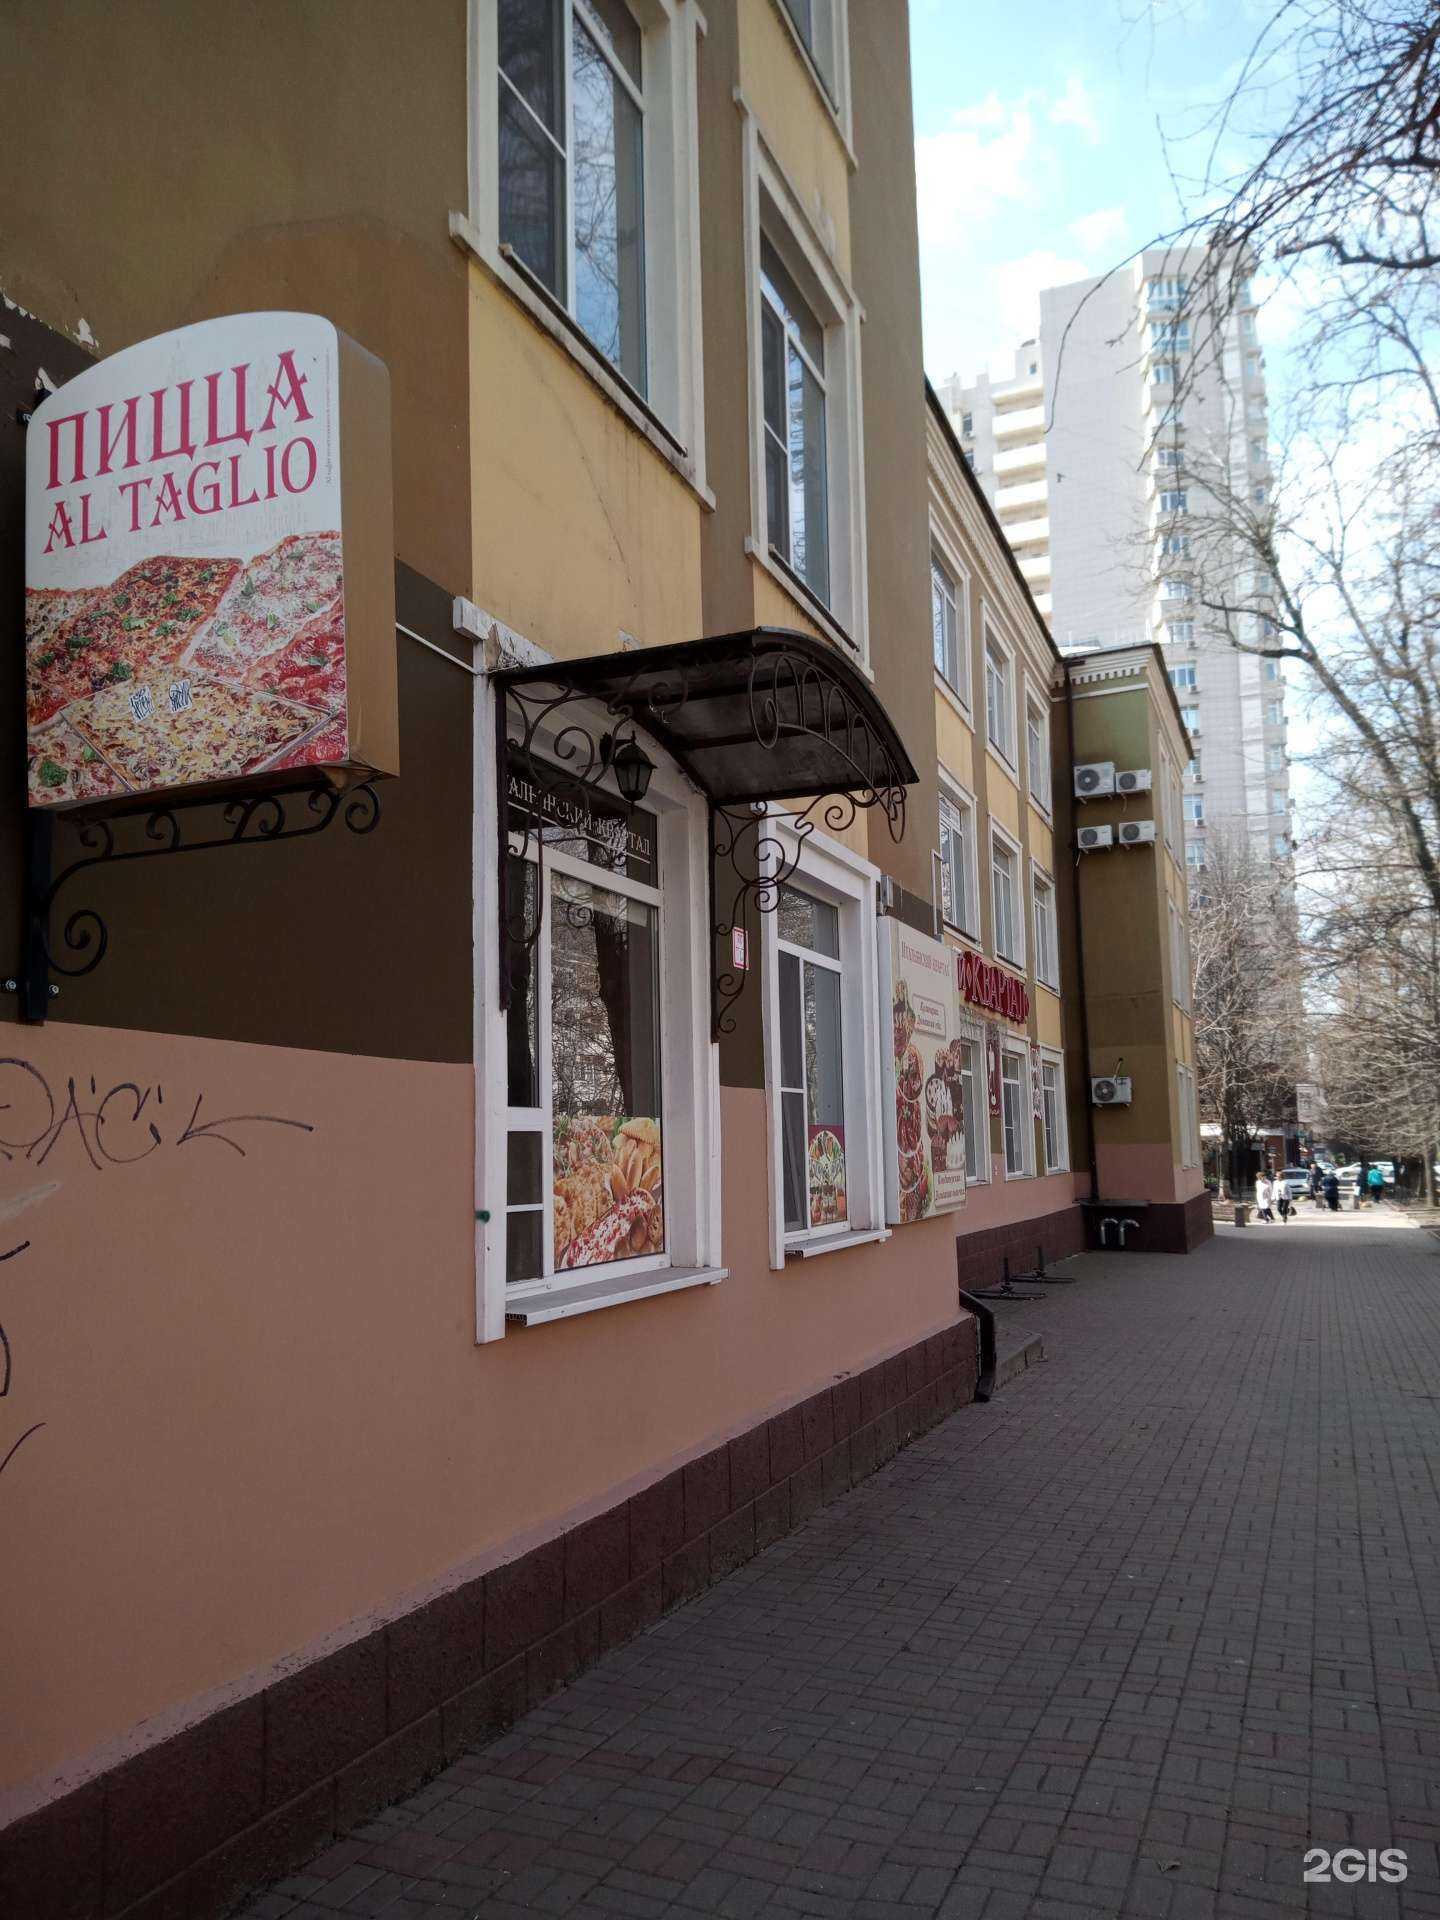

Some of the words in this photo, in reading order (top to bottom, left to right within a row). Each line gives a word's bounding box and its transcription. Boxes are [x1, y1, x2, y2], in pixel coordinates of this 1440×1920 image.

[45, 349, 314, 490] ПИЦЦА
[43, 494, 108, 554] AL
[118, 436, 317, 532] TAGLIO
